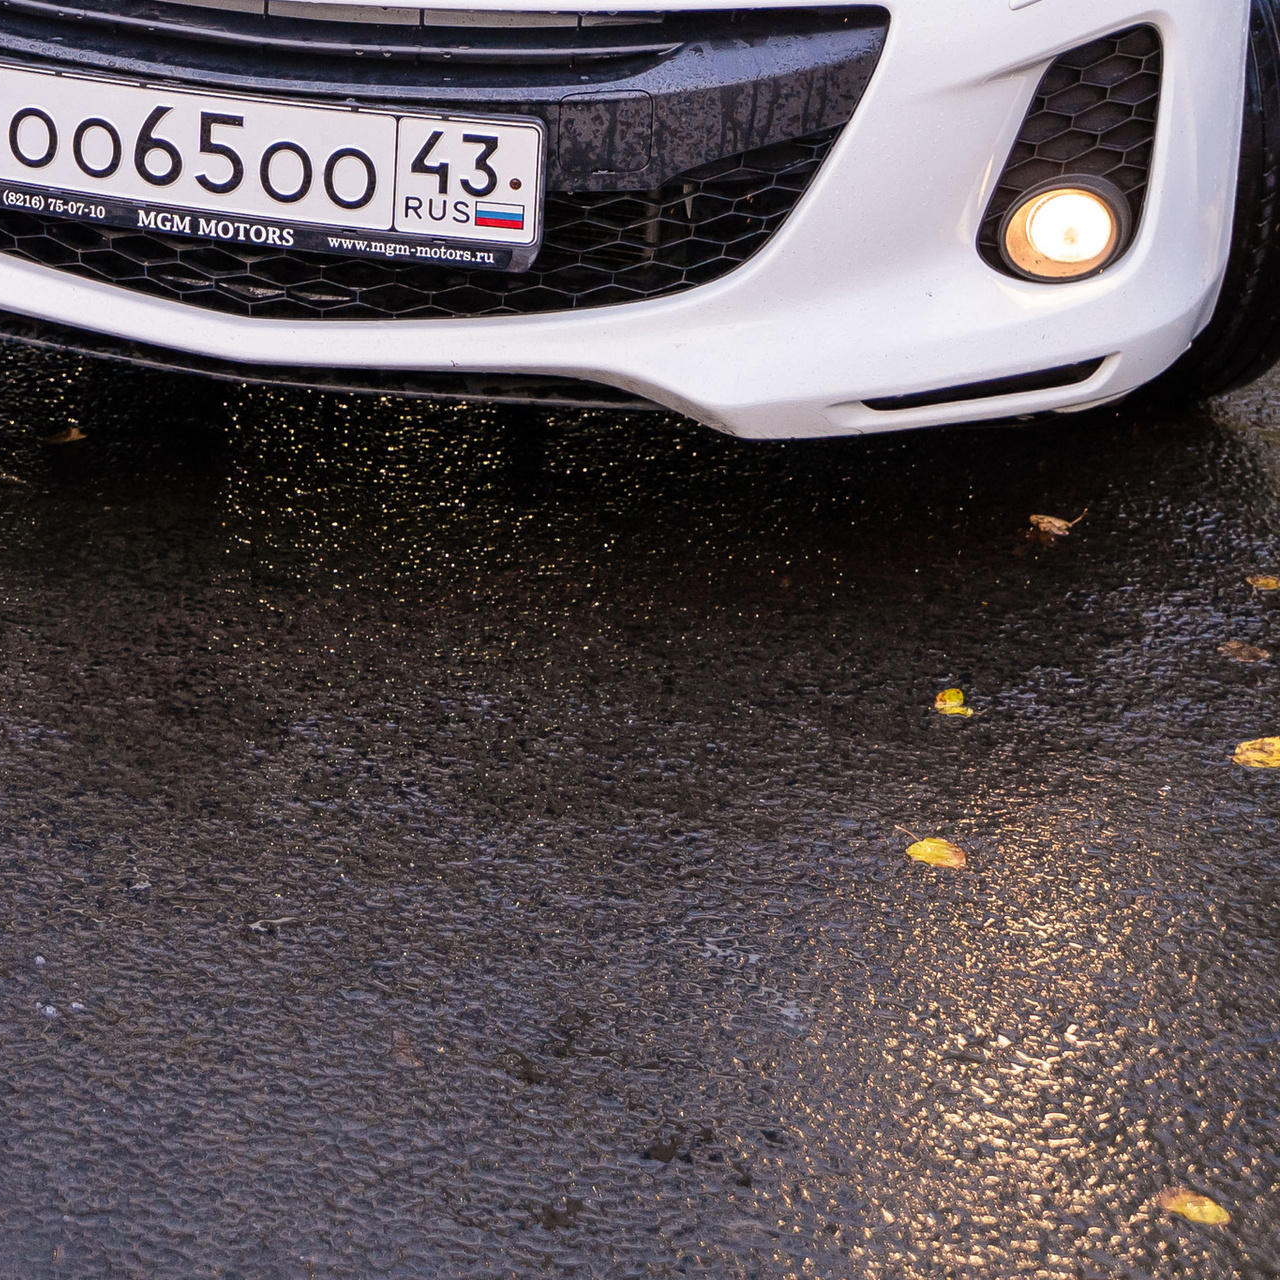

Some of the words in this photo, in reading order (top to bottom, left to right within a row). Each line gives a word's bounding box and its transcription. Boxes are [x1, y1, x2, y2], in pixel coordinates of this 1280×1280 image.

[410, 130, 499, 197] 43
[2, 189, 45, 211] (8216)
[47, 198, 106, 219] 75-07-10
[405, 196, 471, 223] RUS
[137, 209, 192, 234] MGM
[198, 217, 295, 247] MOTORS
[327, 236, 495, 264] www.mgm-motors.ru
